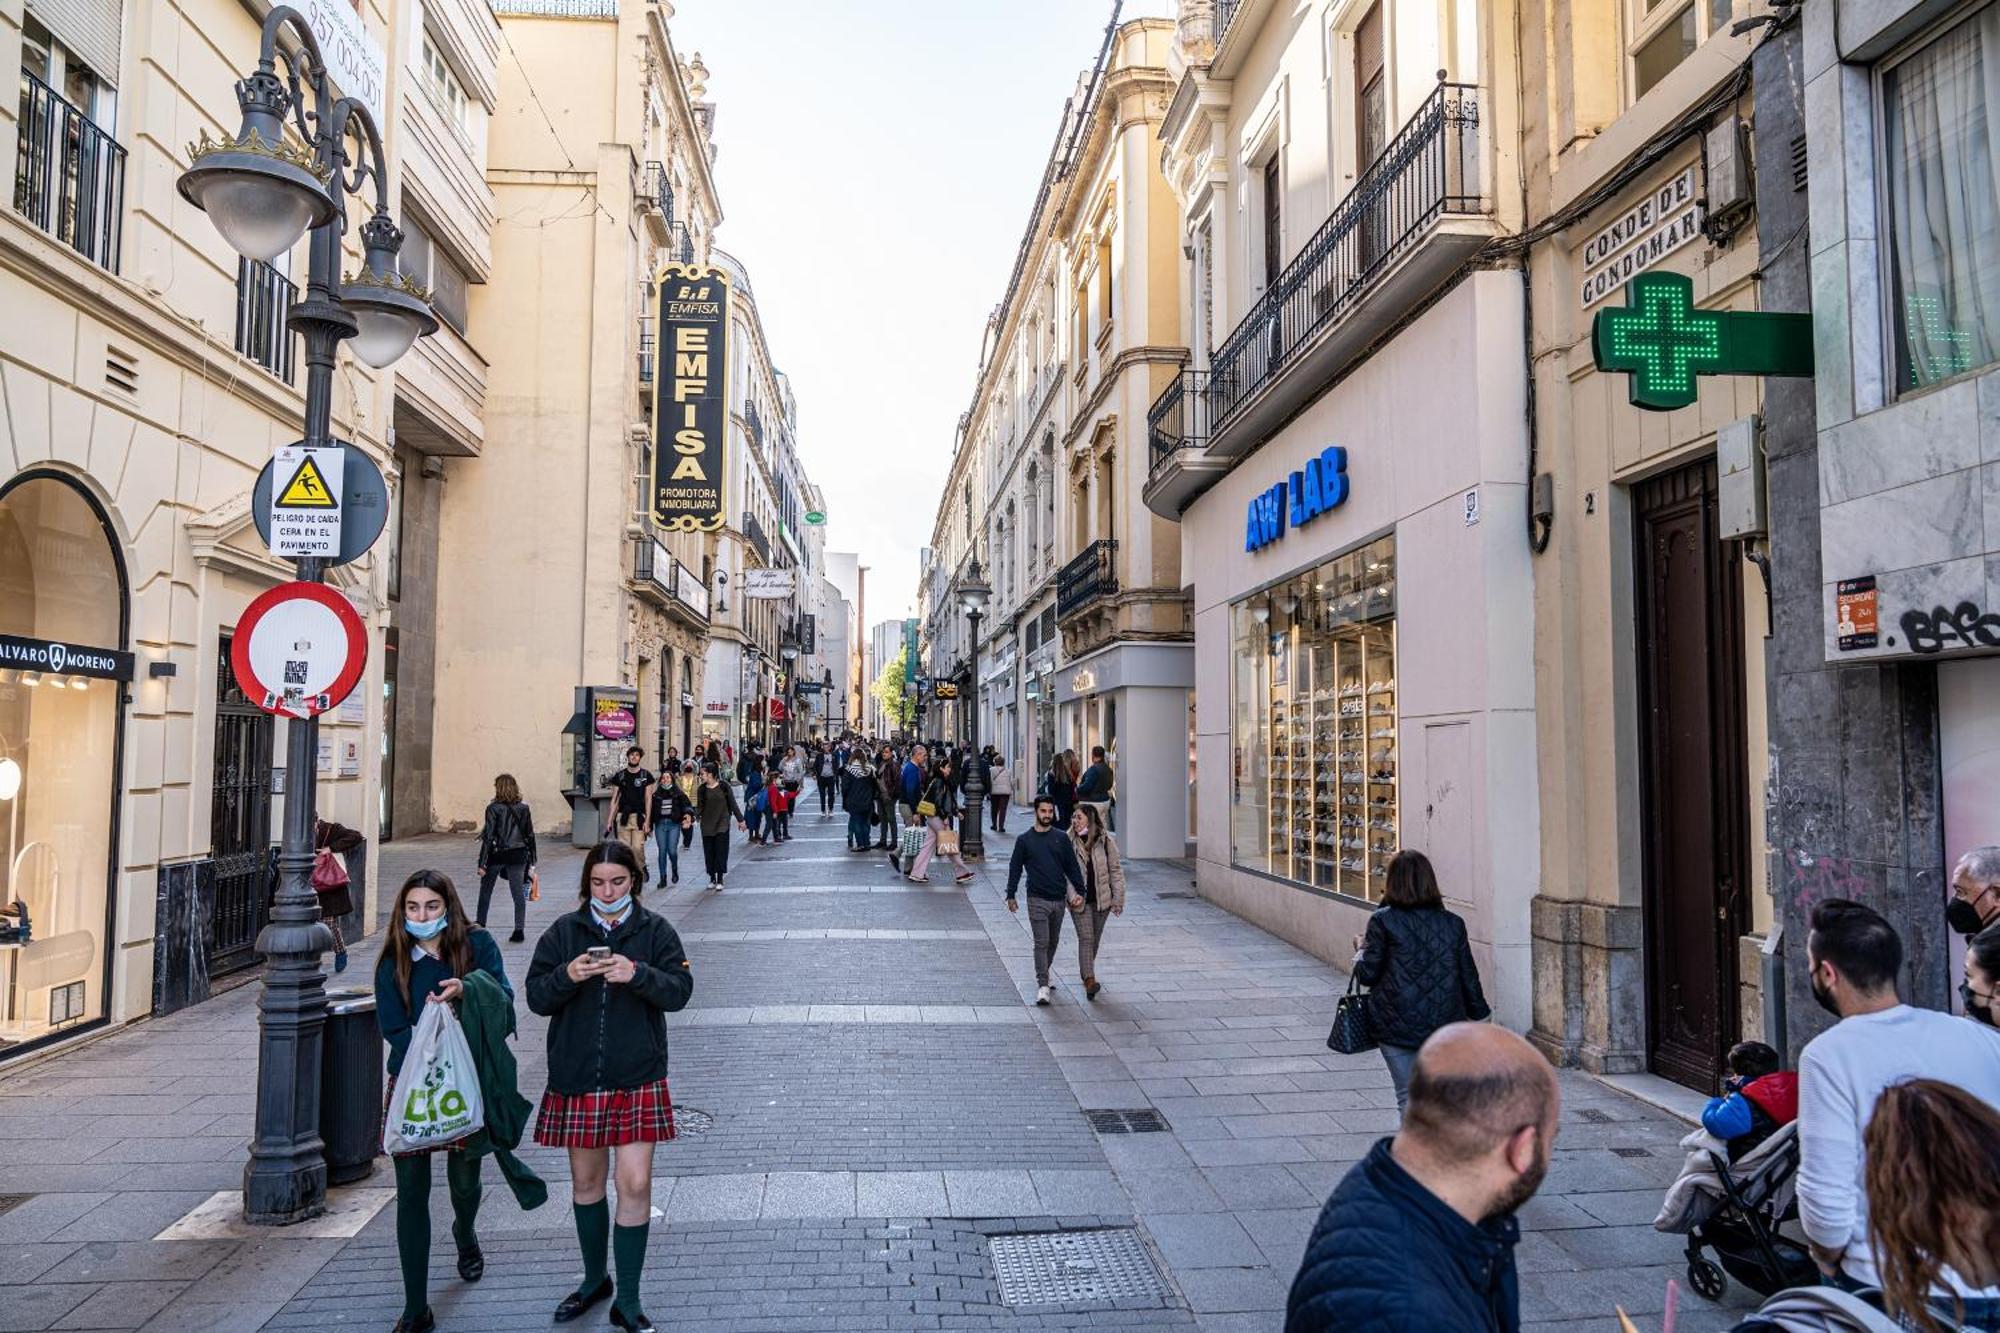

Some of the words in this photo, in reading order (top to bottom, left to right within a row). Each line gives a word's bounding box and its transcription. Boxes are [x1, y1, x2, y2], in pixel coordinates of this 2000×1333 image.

[310, 1, 334, 49] 957
[336, 38, 360, 85] 004
[1584, 205, 1652, 266] CONDE
[1658, 175, 1688, 214] DE
[1582, 210, 1696, 305] GONDOMAR
[669, 303, 719, 315] EMFISA
[670, 327, 709, 481] EMFISA
[660, 488, 717, 498] PROMOTORA
[1246, 482, 1288, 553] AW
[1289, 446, 1350, 529] LAB
[660, 499, 717, 509] INMOBILIARIA
[1585, 493, 1595, 515] 2
[272, 514, 304, 523] PELIGRO
[306, 514, 316, 523] DE
[305, 528, 316, 536] EN
[320, 528, 331, 536] EL
[280, 541, 329, 550] PAVIMENTO
[67, 653, 116, 671] MORENO
